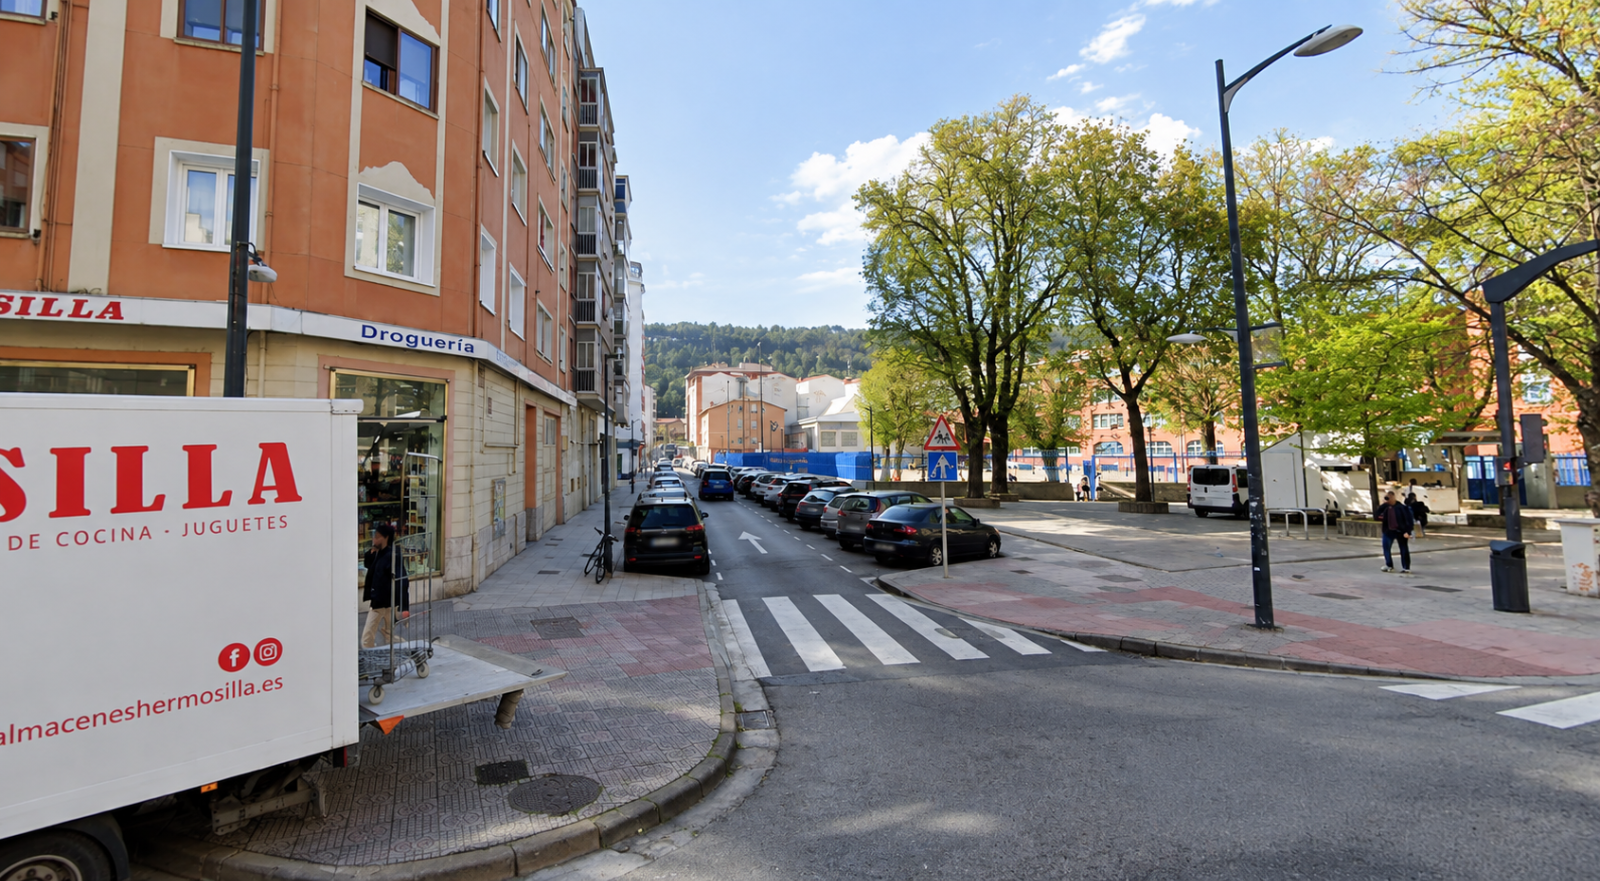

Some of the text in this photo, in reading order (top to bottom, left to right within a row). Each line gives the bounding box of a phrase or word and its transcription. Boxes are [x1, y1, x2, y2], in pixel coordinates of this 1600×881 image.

[361, 324, 475, 353] Droguería
[8, 533, 40, 551] DE
[55, 525, 152, 547] COCINA
[182, 515, 288, 537] JUGUETES
